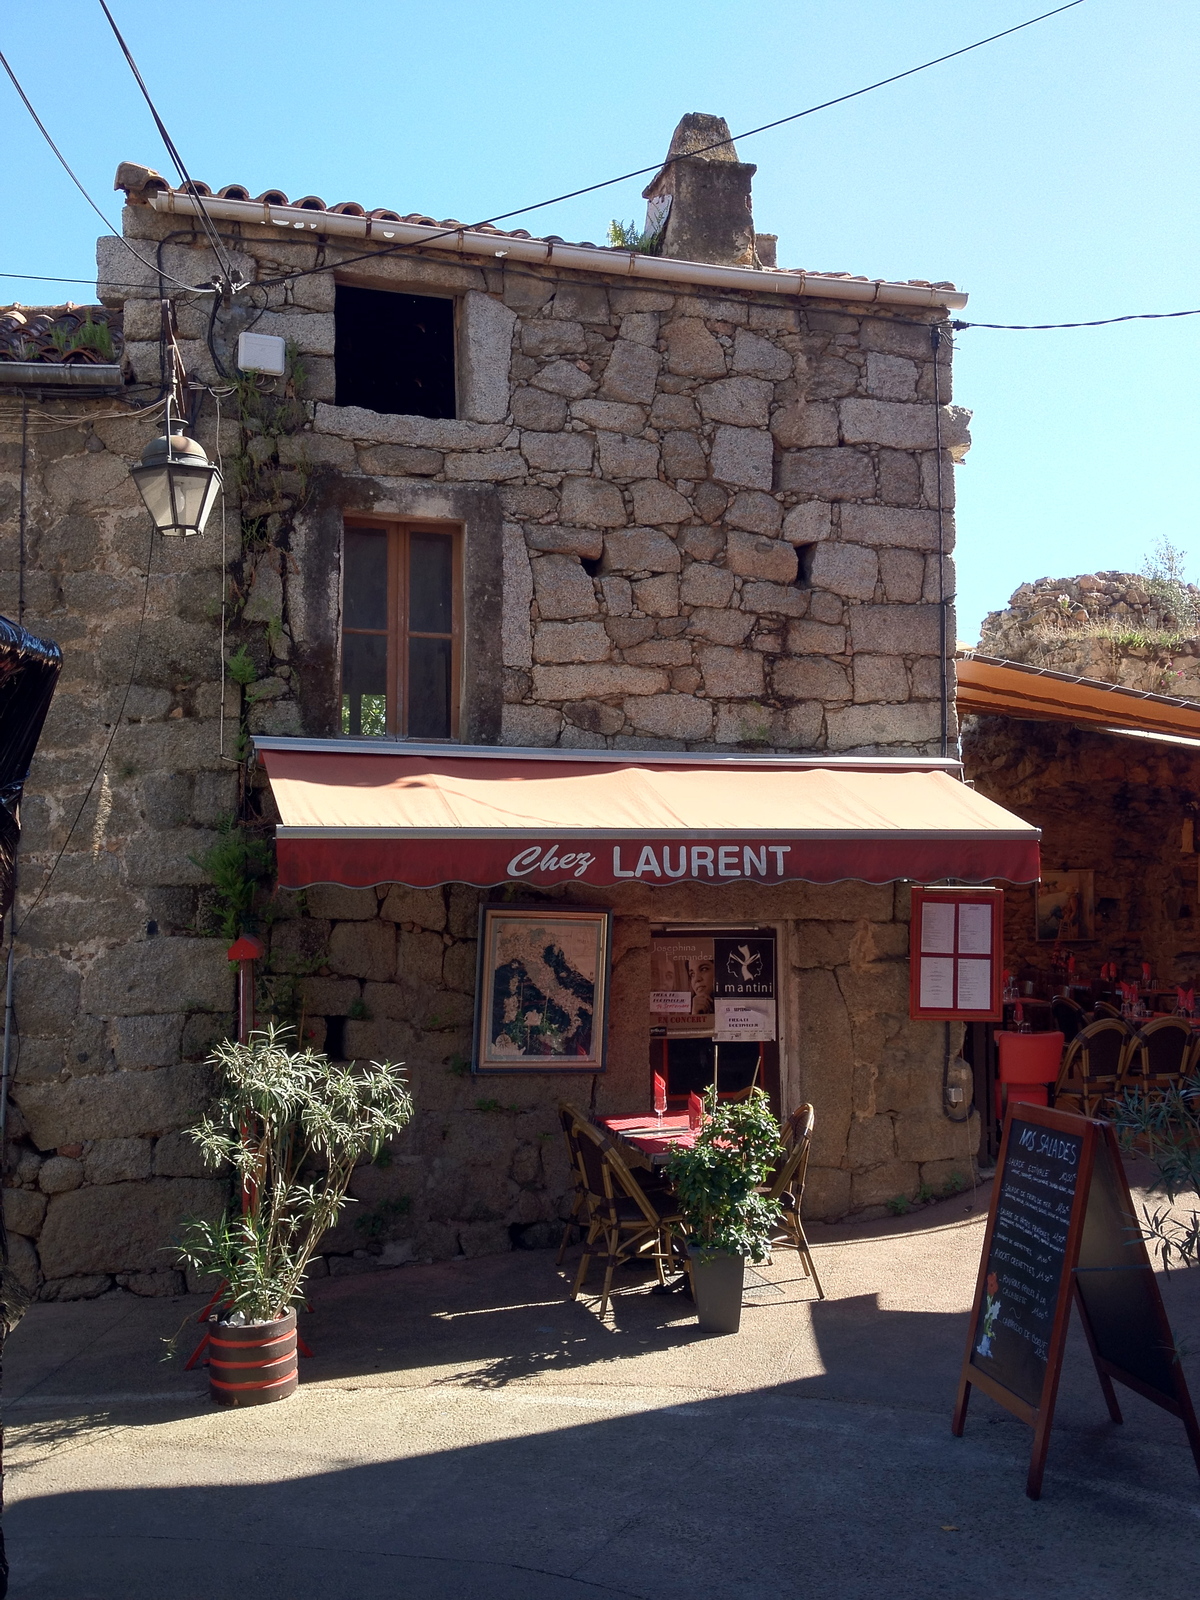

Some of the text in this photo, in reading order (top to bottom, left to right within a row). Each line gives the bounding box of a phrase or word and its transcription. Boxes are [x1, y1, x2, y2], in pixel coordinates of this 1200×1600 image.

[507, 844, 791, 878] Chez LAURENT
[651, 942, 696, 954] Josephina
[665, 952, 713, 962] Fernandez
[716, 981, 773, 993] i mantini
[1019, 1128, 1076, 1165] NOS SALADES
